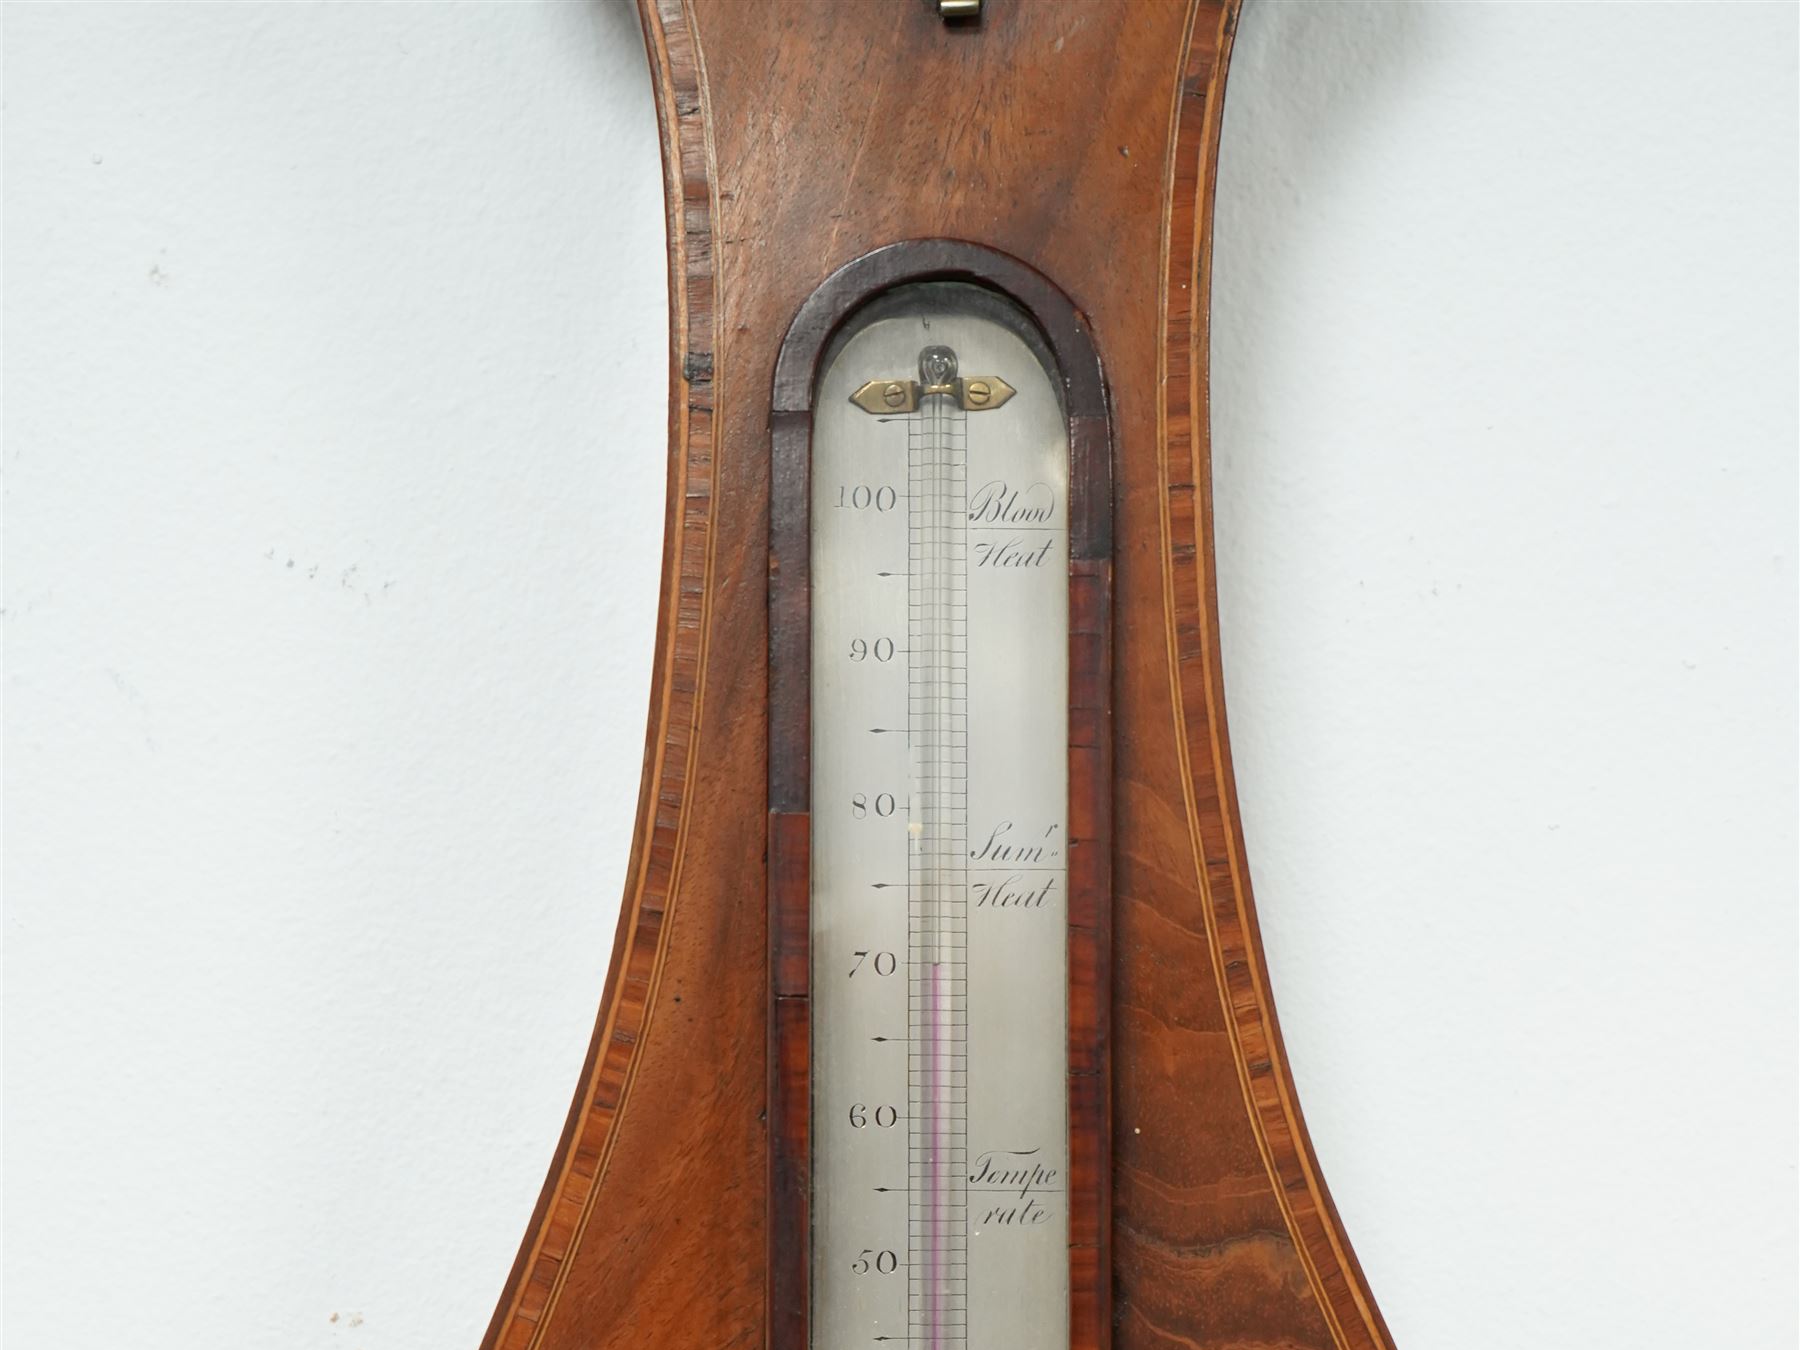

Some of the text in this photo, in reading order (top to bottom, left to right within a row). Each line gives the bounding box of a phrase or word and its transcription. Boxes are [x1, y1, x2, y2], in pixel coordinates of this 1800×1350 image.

[832, 484, 897, 513] 100
[968, 480, 1055, 524] Blood
[973, 538, 1054, 568] Heat
[849, 636, 895, 663] 90
[852, 792, 895, 820] 80
[971, 873, 1058, 909] Heat
[848, 950, 897, 979] 70
[848, 1103, 898, 1129] 60
[968, 1147, 1058, 1200] Tempe
[976, 1199, 1054, 1226] rate
[851, 1249, 898, 1275] 50
